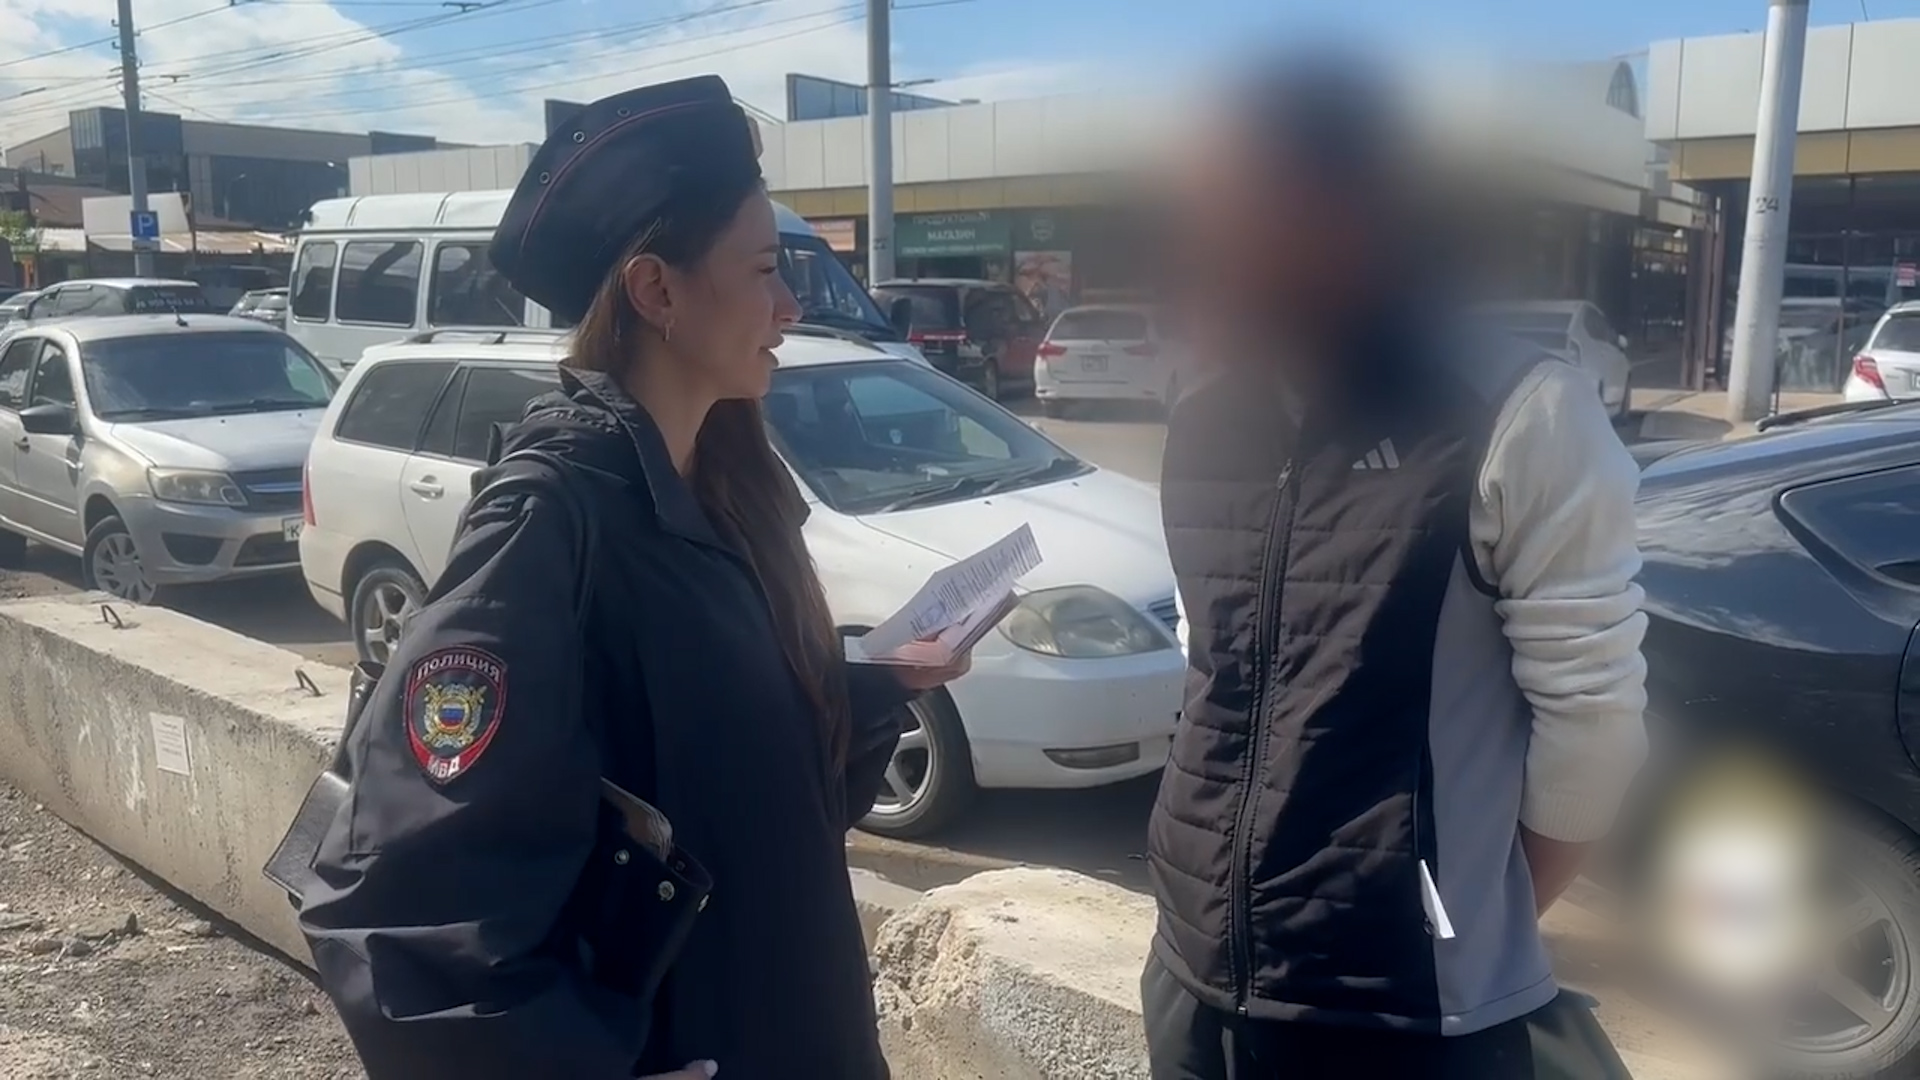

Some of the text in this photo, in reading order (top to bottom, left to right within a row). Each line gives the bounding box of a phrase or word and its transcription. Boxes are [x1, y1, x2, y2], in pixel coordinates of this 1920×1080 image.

[1755, 197, 1779, 214] 24
[138, 213, 155, 236] P
[927, 228, 976, 242] МАГАЗИН
[416, 653, 502, 684] ПОЛИЦИЯ
[426, 755, 461, 779] МВД
